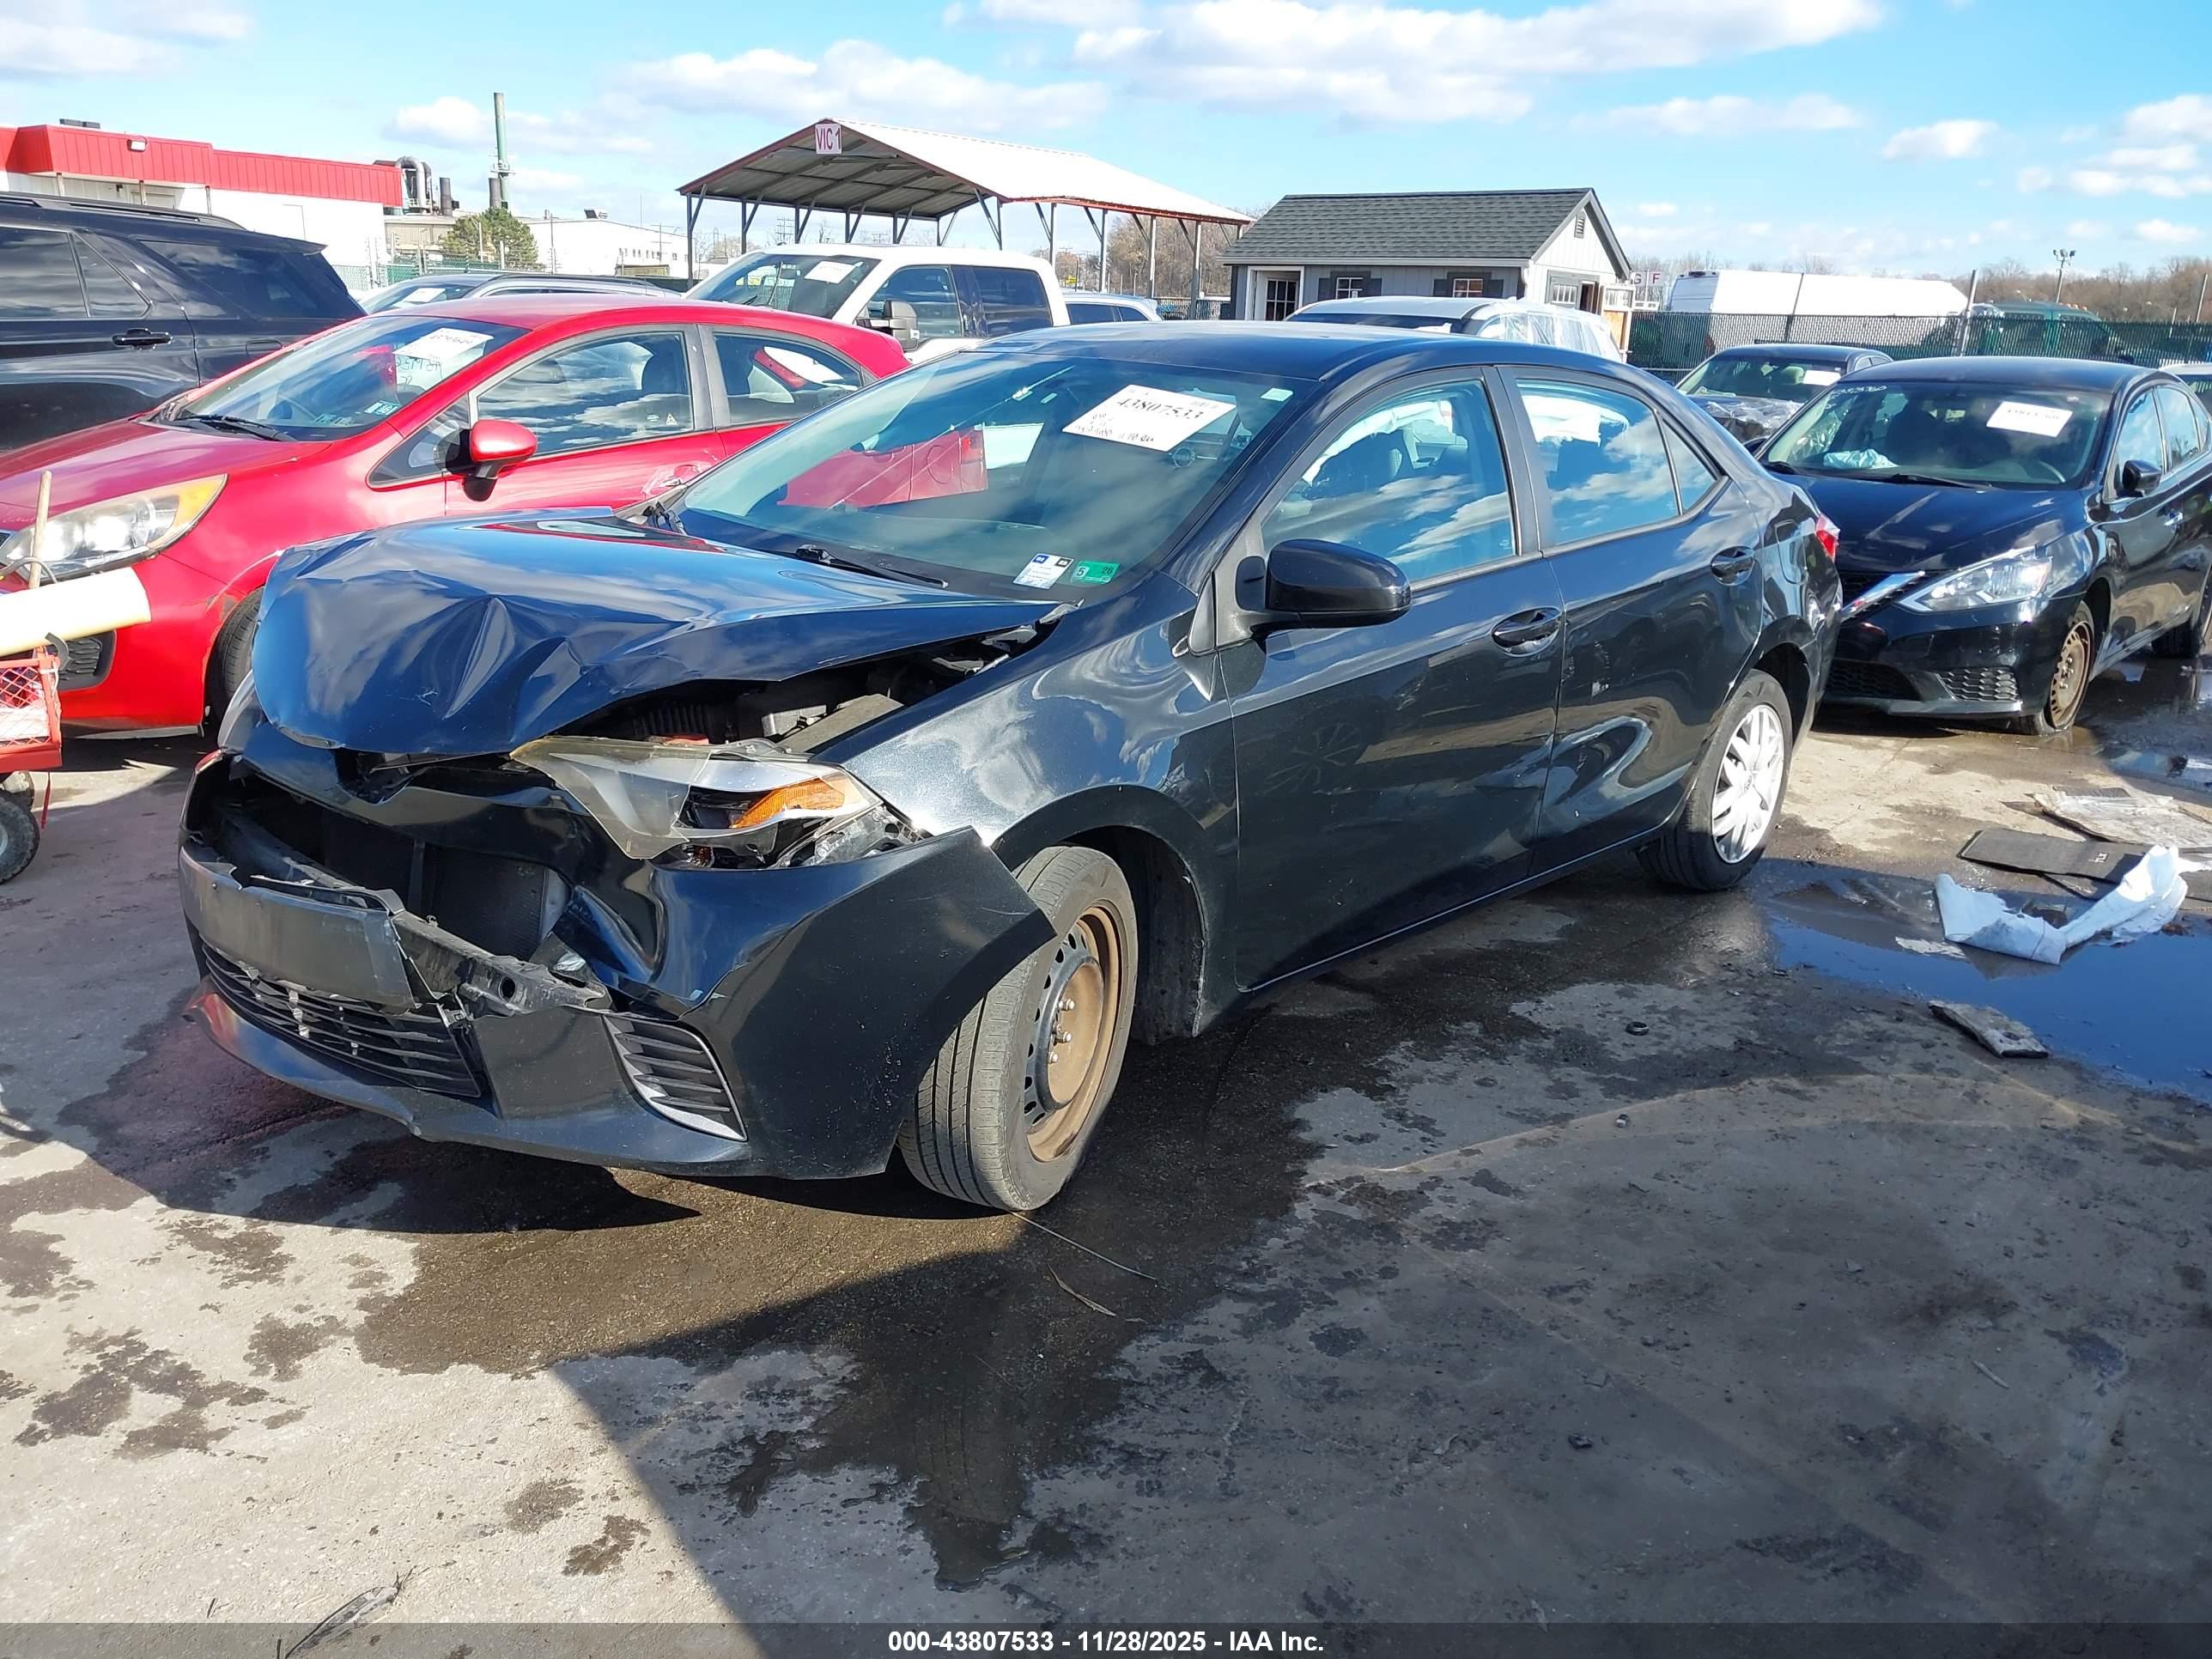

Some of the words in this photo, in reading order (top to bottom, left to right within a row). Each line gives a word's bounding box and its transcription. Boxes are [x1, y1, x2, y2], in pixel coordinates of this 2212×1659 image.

[816, 128, 833, 150] VIC
[836, 127, 842, 150] 1
[1652, 273, 1661, 284] F
[1116, 398, 1205, 420] 43807533
[1077, 567, 1086, 576] 5
